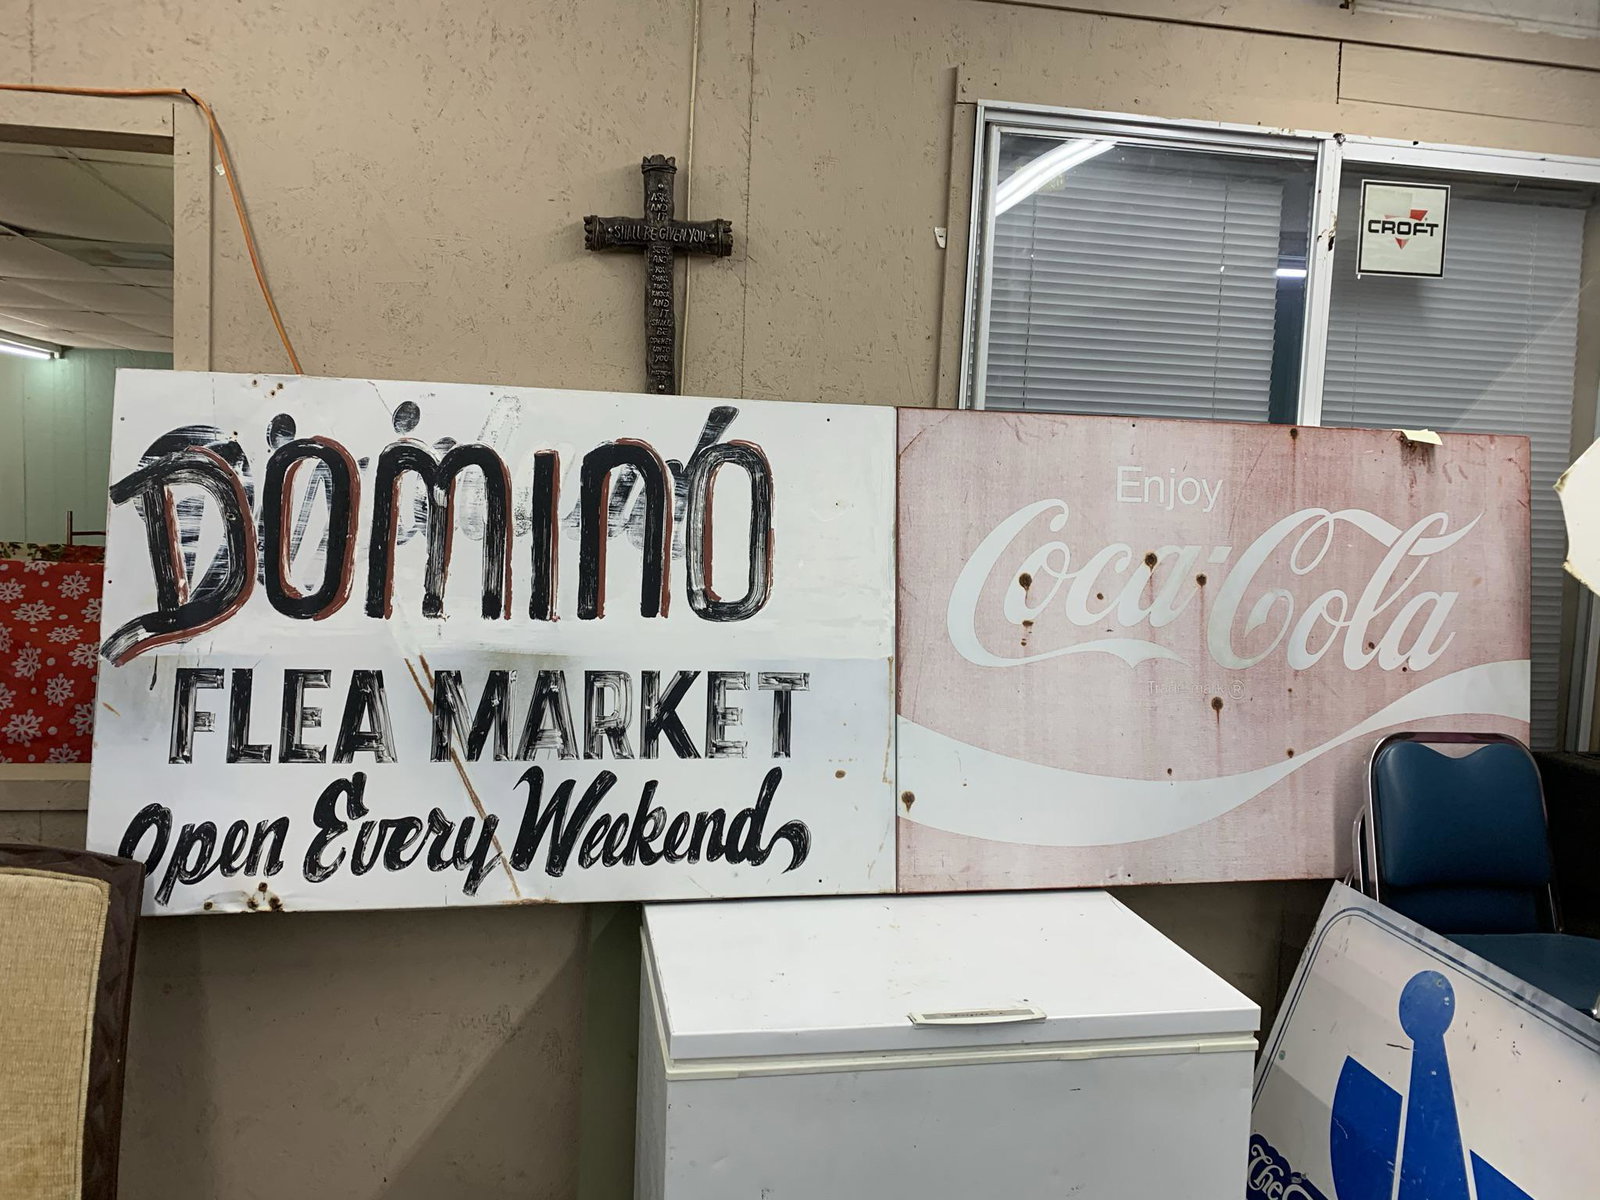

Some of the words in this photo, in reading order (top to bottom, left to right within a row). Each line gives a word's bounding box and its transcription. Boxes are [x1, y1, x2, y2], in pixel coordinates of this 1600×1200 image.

[650, 203, 668, 211] AND
[657, 212, 668, 220] IT
[614, 225, 641, 240] SHALL
[643, 225, 657, 240] BE
[659, 226, 687, 242] GIVEN
[688, 227, 706, 243] YOU
[1367, 219, 1439, 237] CROFT
[652, 245, 670, 255] SEEK
[652, 299, 670, 307] AND
[659, 309, 670, 318] IT
[654, 354, 669, 363] YOU
[1115, 465, 1223, 512] Enjoy
[946, 498, 1484, 671] Coca-Cola
[168, 668, 398, 764] FLEA
[430, 670, 810, 763] MARKET
[117, 803, 289, 906] Open
[302, 772, 504, 896] Every
[1248, 1144, 1284, 1200] The
